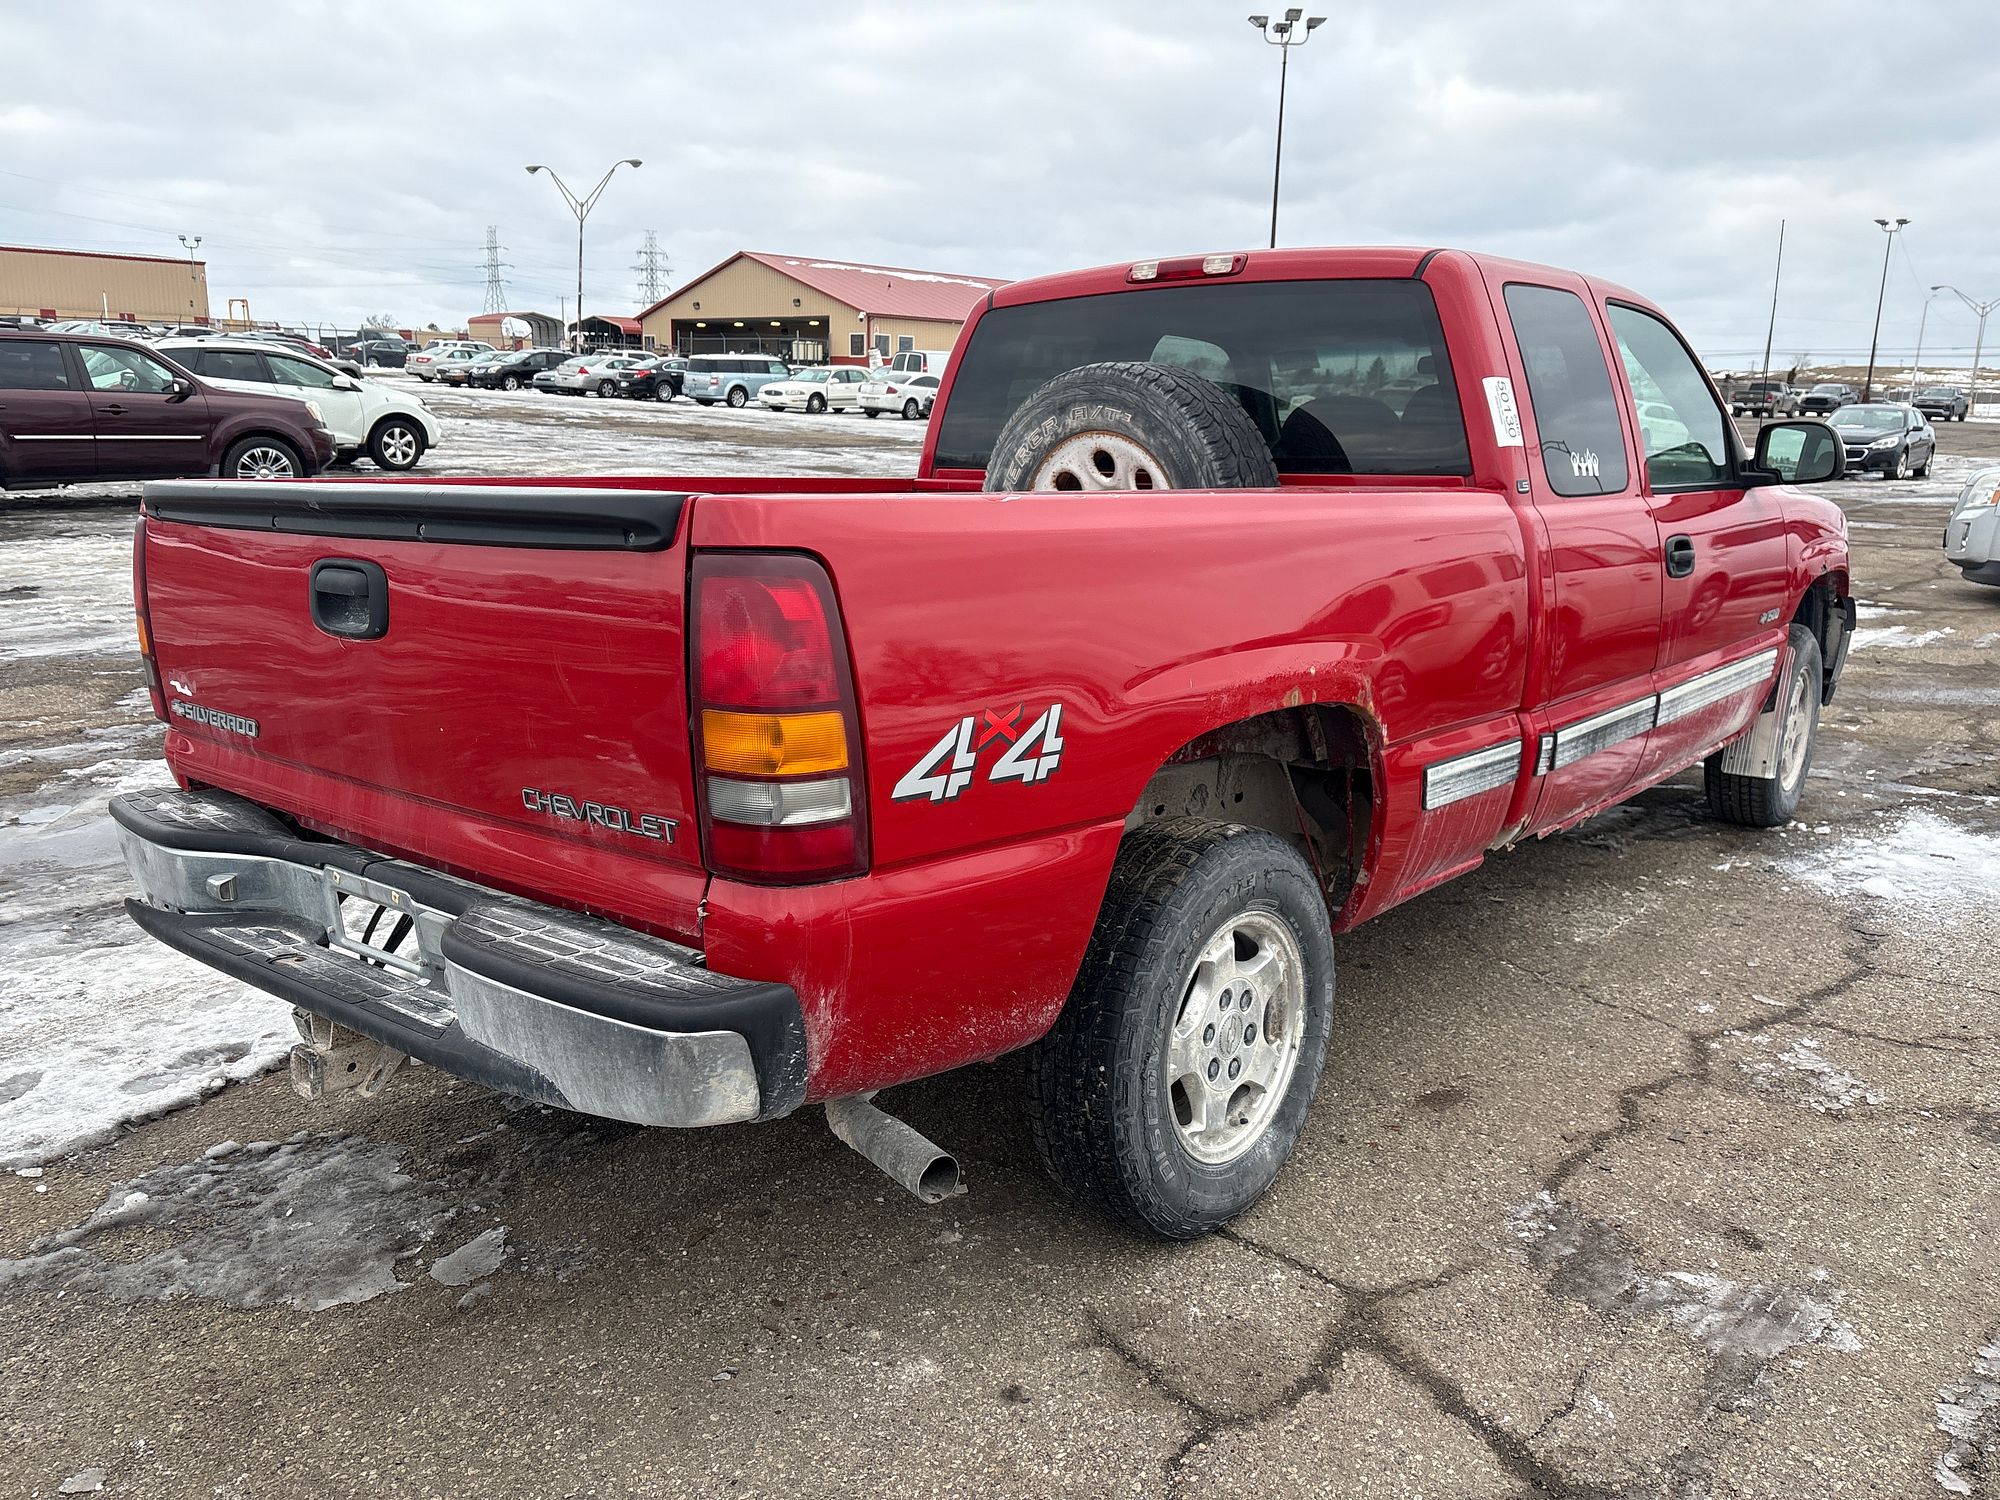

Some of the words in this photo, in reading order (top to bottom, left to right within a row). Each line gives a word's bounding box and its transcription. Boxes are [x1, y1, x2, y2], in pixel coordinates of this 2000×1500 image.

[1496, 380, 1517, 438] 50130
[184, 703, 259, 738] SILVERADO
[521, 787, 679, 843] CHEVROLET
